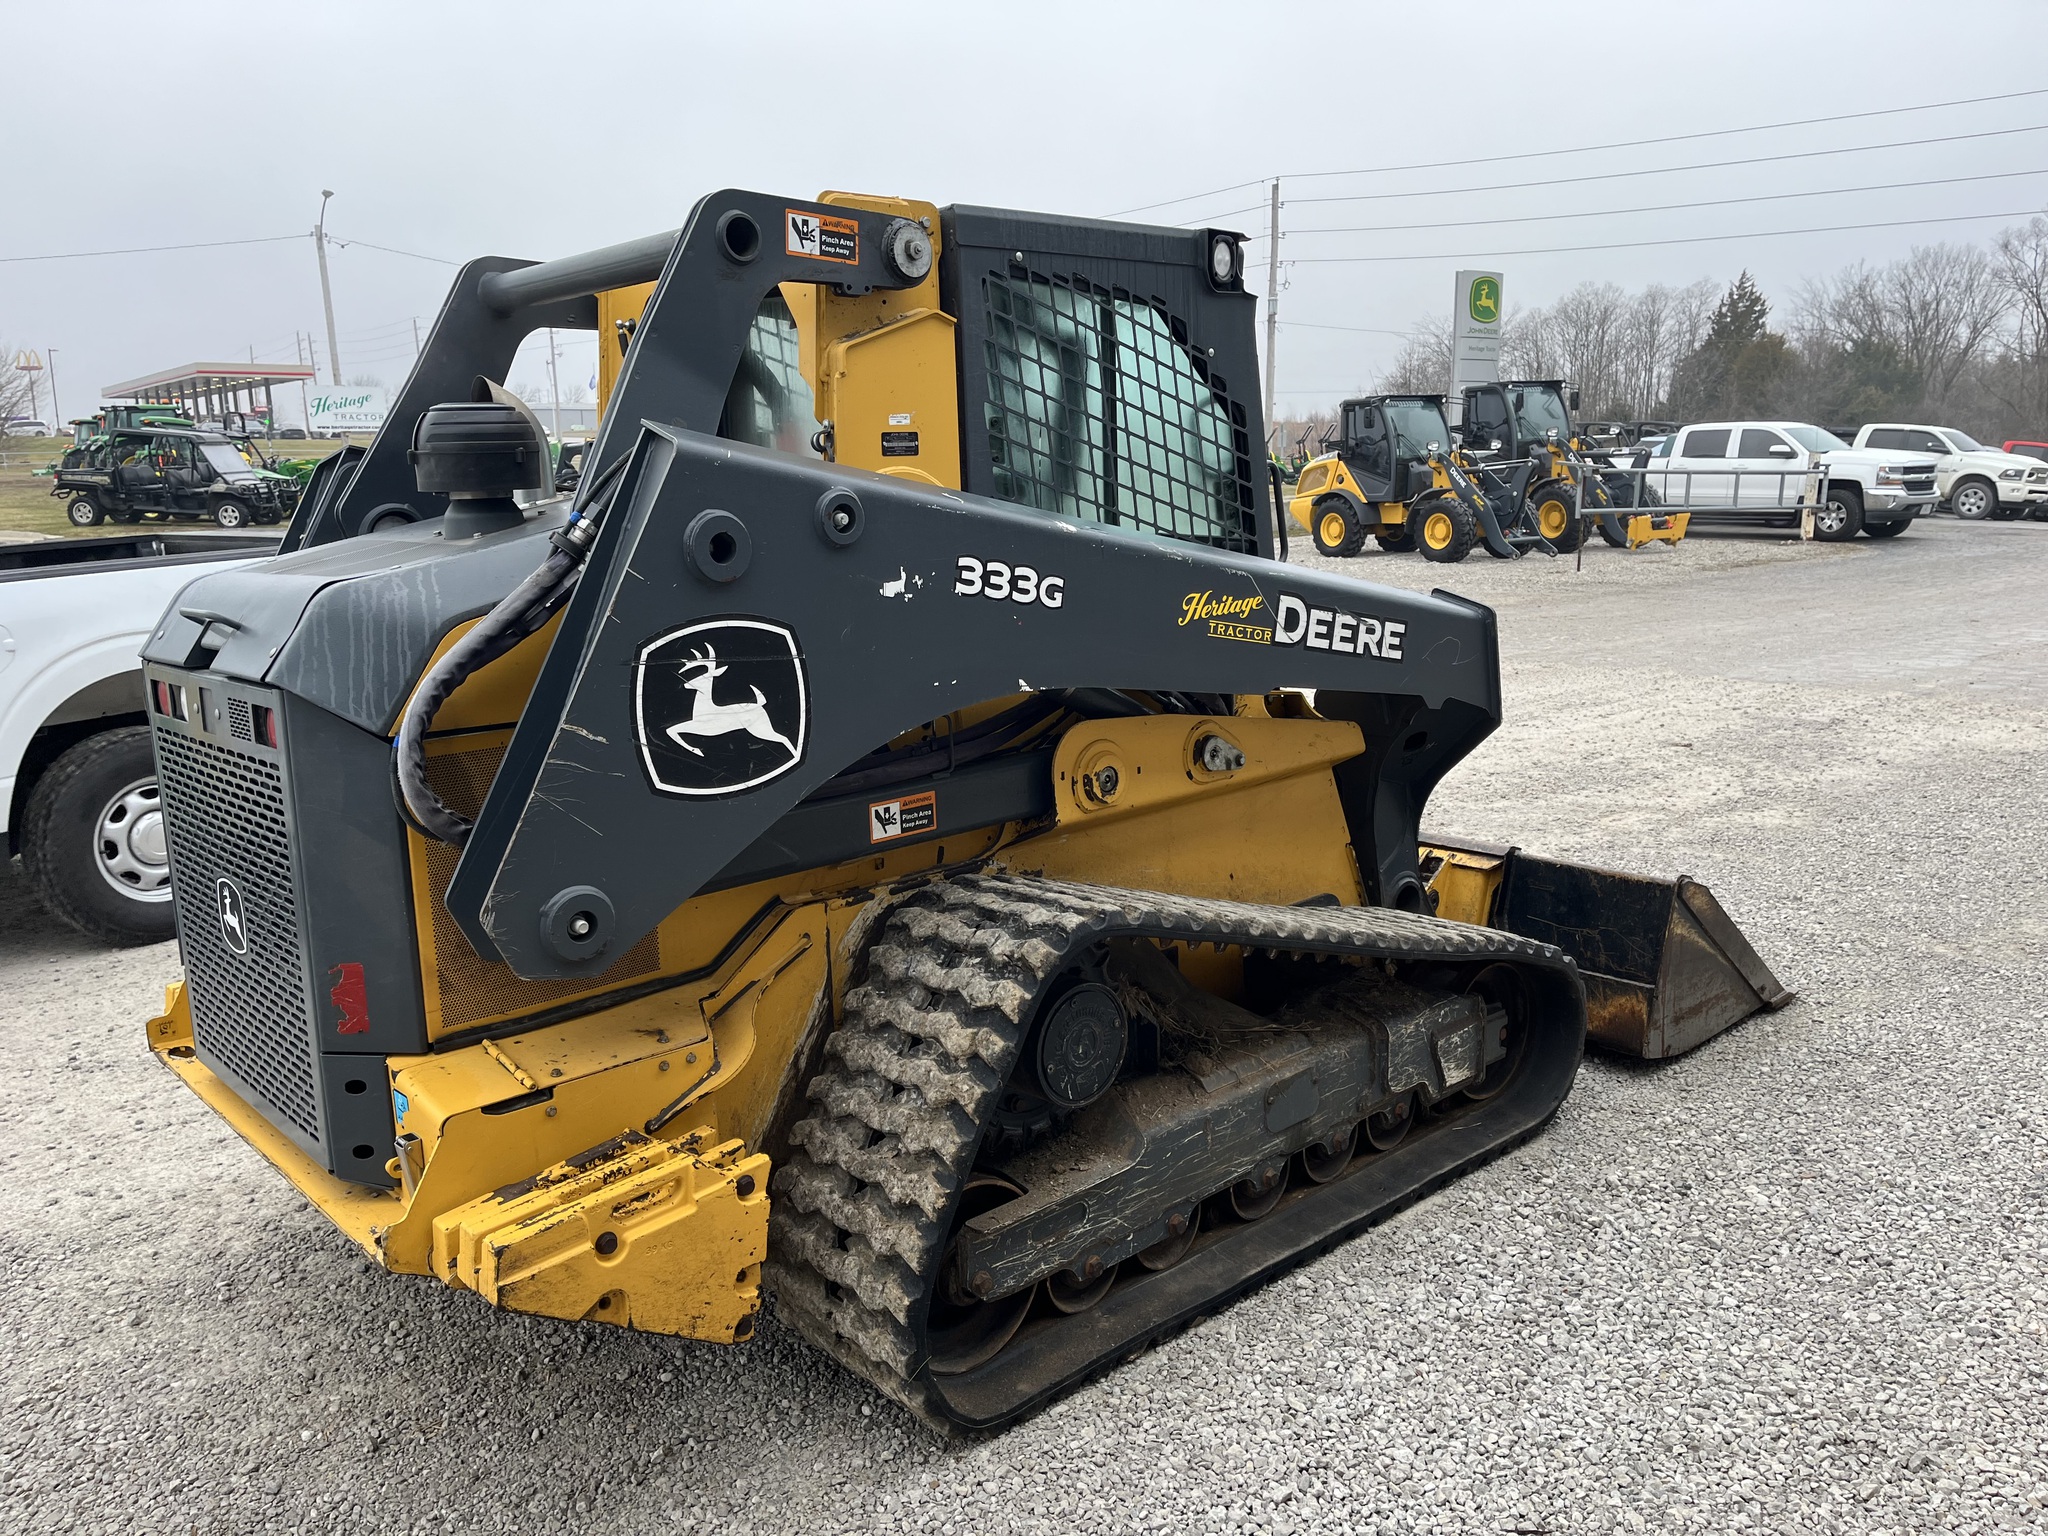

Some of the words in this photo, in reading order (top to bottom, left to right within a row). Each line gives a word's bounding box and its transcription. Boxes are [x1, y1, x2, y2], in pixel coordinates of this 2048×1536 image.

[821, 234, 839, 245] Pinch
[839, 238, 854, 247] Area
[821, 244, 836, 254] Keep
[835, 246, 850, 256] Away
[1467, 326, 1483, 334] JOHN
[310, 394, 372, 418] Heritage
[333, 413, 385, 421] TRACTOR
[1449, 466, 1467, 489] DEERE
[955, 556, 1064, 608] 333G
[1178, 590, 1264, 627] Heritage
[1209, 622, 1273, 642] TRACTOR
[1274, 594, 1406, 660] DEERE
[907, 795, 932, 806] WARNING
[902, 812, 918, 821] Pinch
[918, 809, 932, 818] Area
[902, 821, 915, 829] Keep
[915, 818, 929, 826] Away
